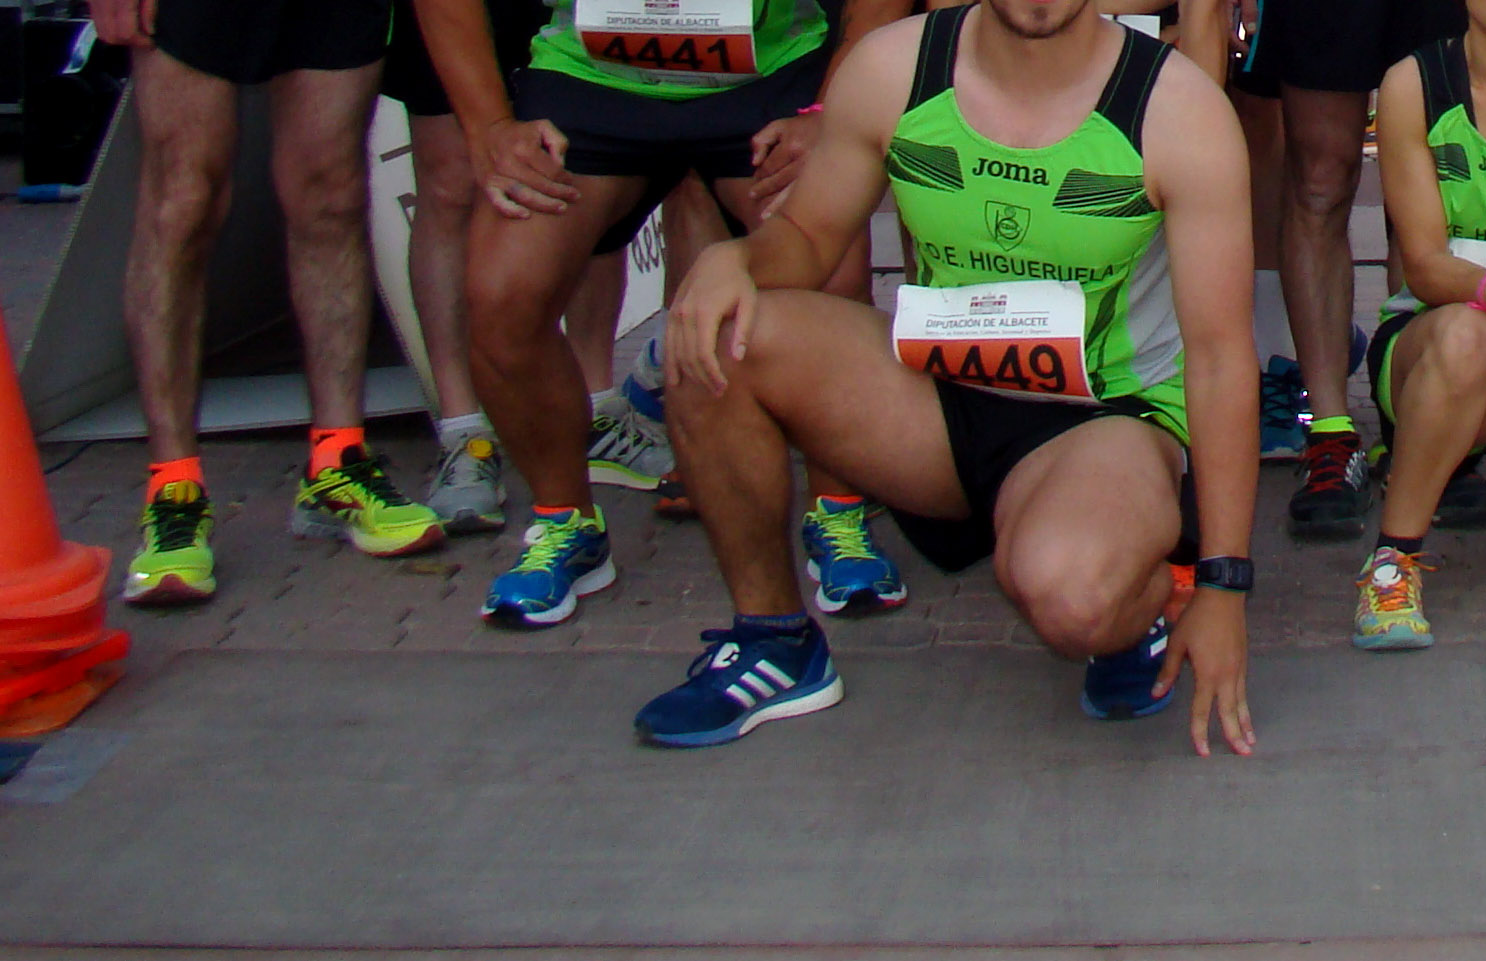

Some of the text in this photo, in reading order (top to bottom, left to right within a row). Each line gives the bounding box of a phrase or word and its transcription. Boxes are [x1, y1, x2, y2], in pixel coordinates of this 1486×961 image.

[660, 17, 672, 26] DE
[675, 18, 720, 27] ALBACETE
[602, 35, 731, 73] 4441
[972, 157, 1049, 187] Joma
[925, 316, 1049, 329] DIPUTACIÓN DE ALBACETE
[922, 343, 1067, 393] 4449
